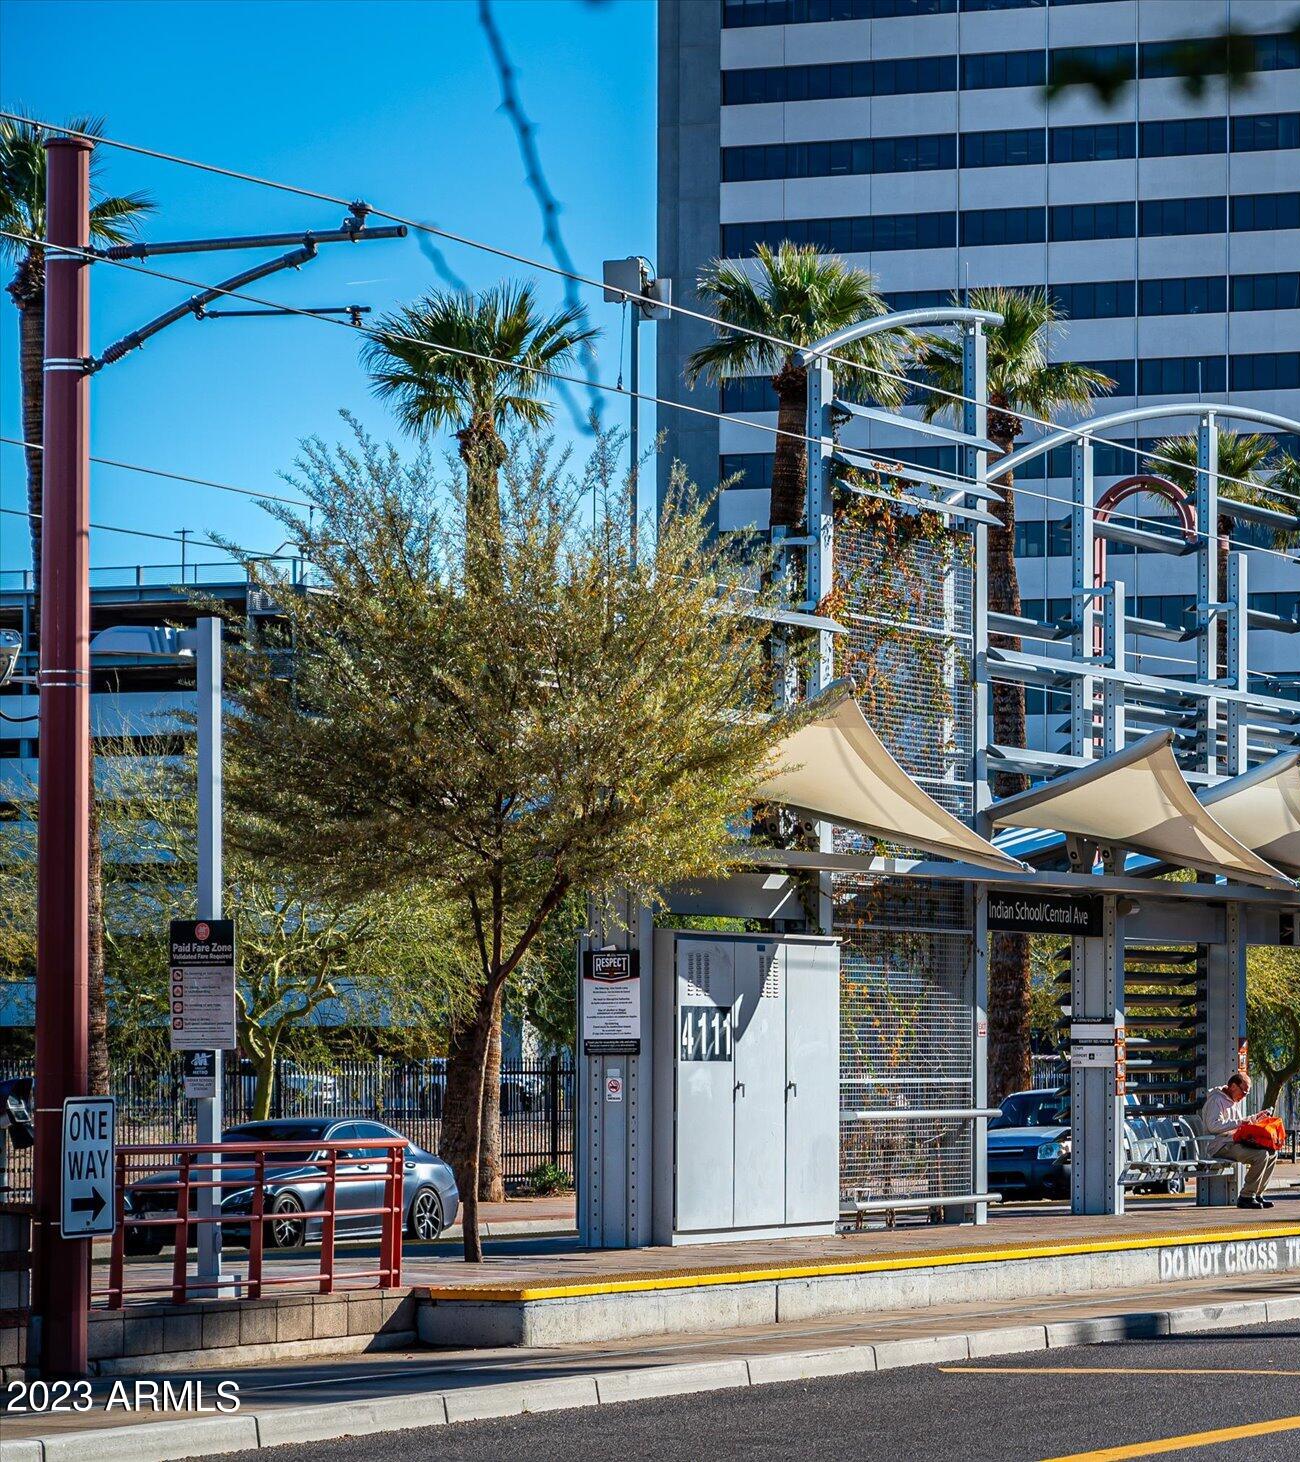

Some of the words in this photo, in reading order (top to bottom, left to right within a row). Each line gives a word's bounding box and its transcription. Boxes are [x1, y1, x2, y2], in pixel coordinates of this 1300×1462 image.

[988, 900, 1014, 919] Indian
[1015, 901, 1072, 923] School/Central
[1073, 906, 1089, 925] Ave
[172, 943, 191, 952] Paid
[192, 943, 210, 952] Fare
[211, 943, 233, 952] Zone
[595, 957, 627, 972] RESPECT
[681, 1012, 731, 1055] 4111
[69, 1110, 108, 1141] ONE
[67, 1149, 109, 1181] WAY
[1160, 1247, 1185, 1281] DO
[1187, 1244, 1222, 1279] NOT
[1225, 1240, 1278, 1274] CROSS
